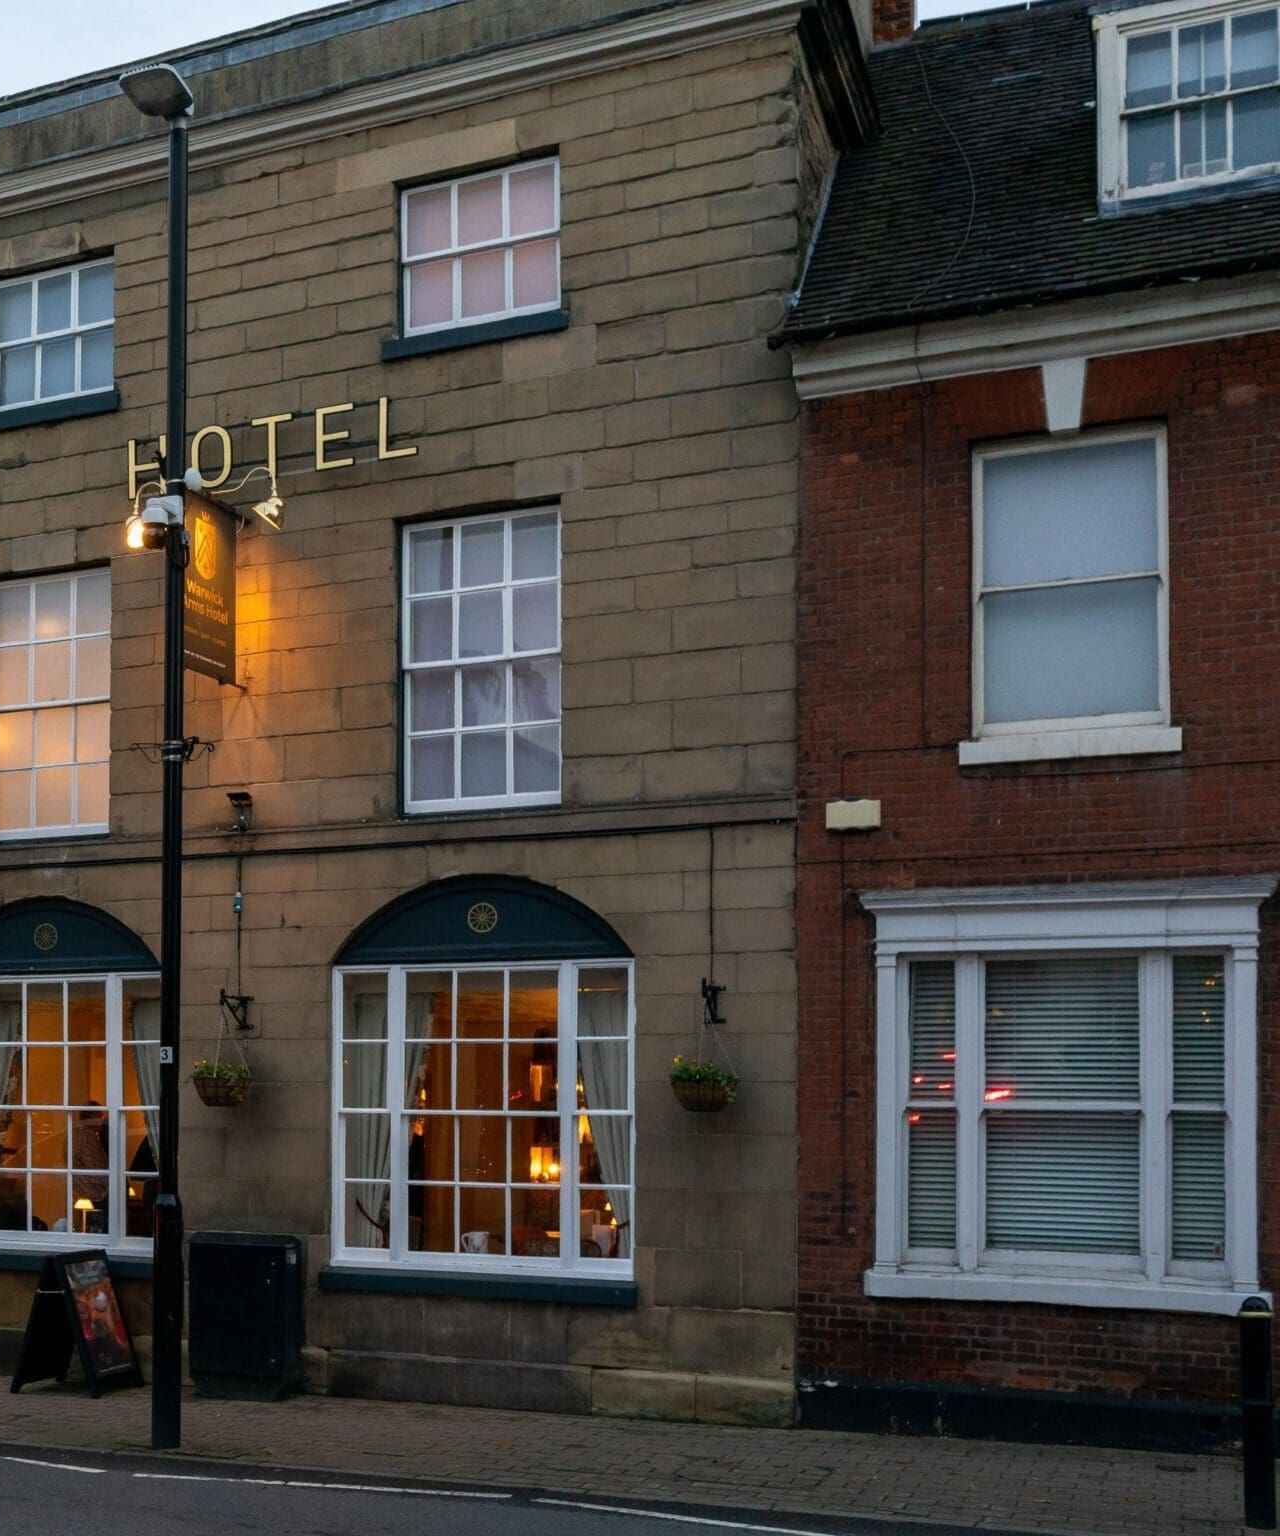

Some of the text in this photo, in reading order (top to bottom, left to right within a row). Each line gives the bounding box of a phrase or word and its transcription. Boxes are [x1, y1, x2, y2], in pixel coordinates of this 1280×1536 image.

[127, 395, 419, 500] HOTEL
[186, 578, 224, 607] Warwick
[206, 604, 228, 625] Hotel
[161, 1048, 169, 1061] 3
